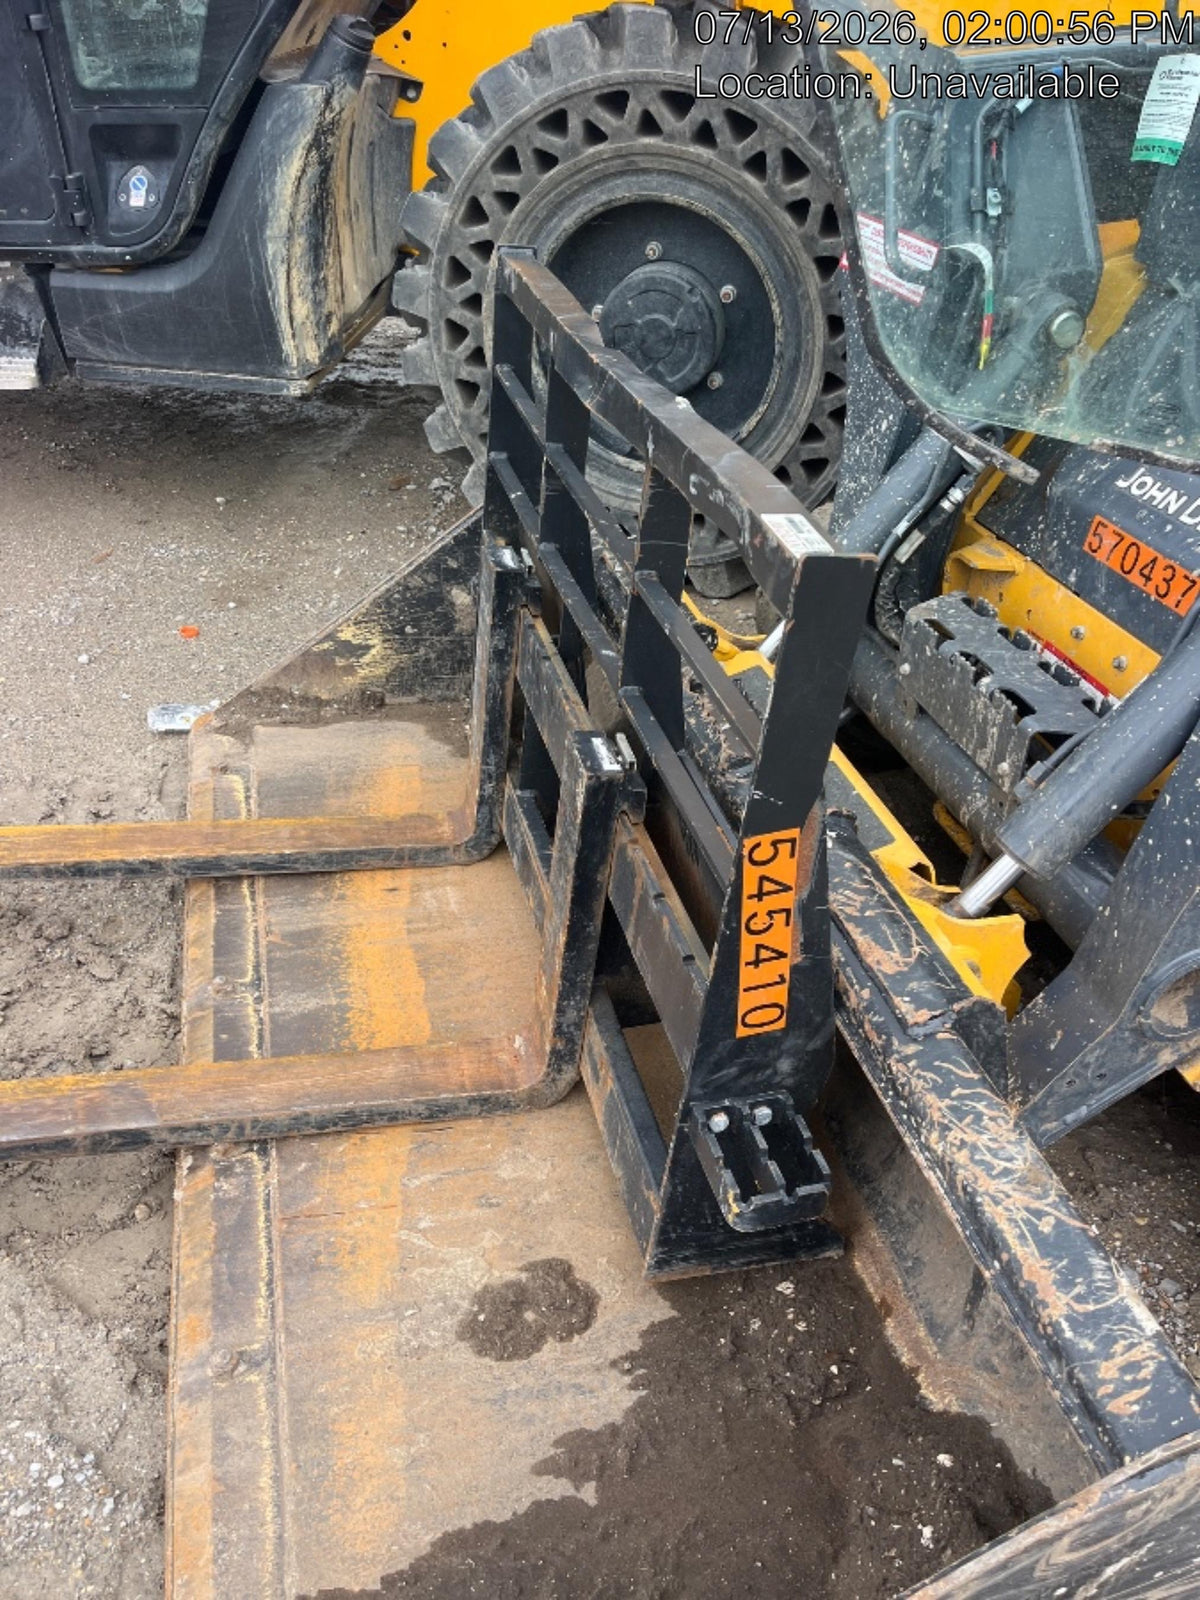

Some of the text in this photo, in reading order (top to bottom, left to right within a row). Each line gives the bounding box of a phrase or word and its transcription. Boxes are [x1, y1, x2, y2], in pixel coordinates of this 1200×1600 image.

[1115, 467, 1200, 531] JOHN D
[1088, 521, 1197, 608] 570437
[741, 837, 797, 1028] 545410
